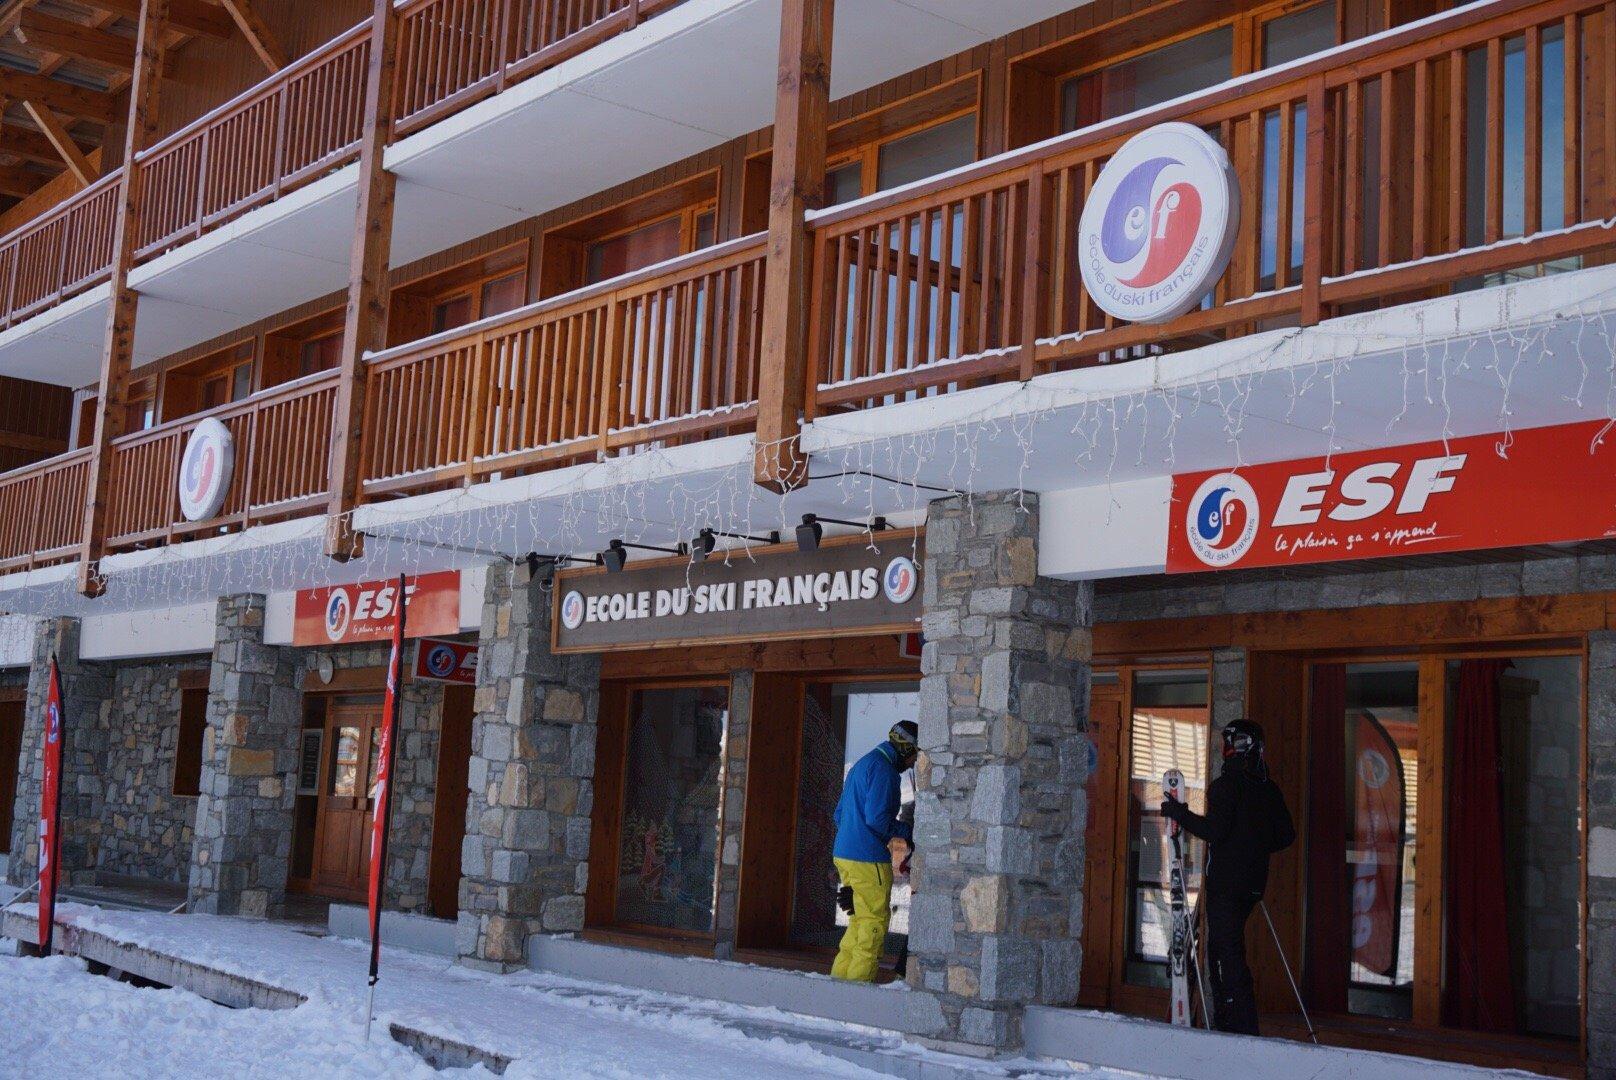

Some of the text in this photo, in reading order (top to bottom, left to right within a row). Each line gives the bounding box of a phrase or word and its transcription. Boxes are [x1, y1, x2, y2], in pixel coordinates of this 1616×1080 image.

[1089, 233, 1105, 285] école
[1149, 234, 1209, 304] français
[1271, 453, 1468, 528] ESF
[1216, 551, 1229, 561] ski
[1290, 532, 1338, 556] plaisir
[585, 567, 879, 622] ECOLE DU SKI FRANÇAIS
